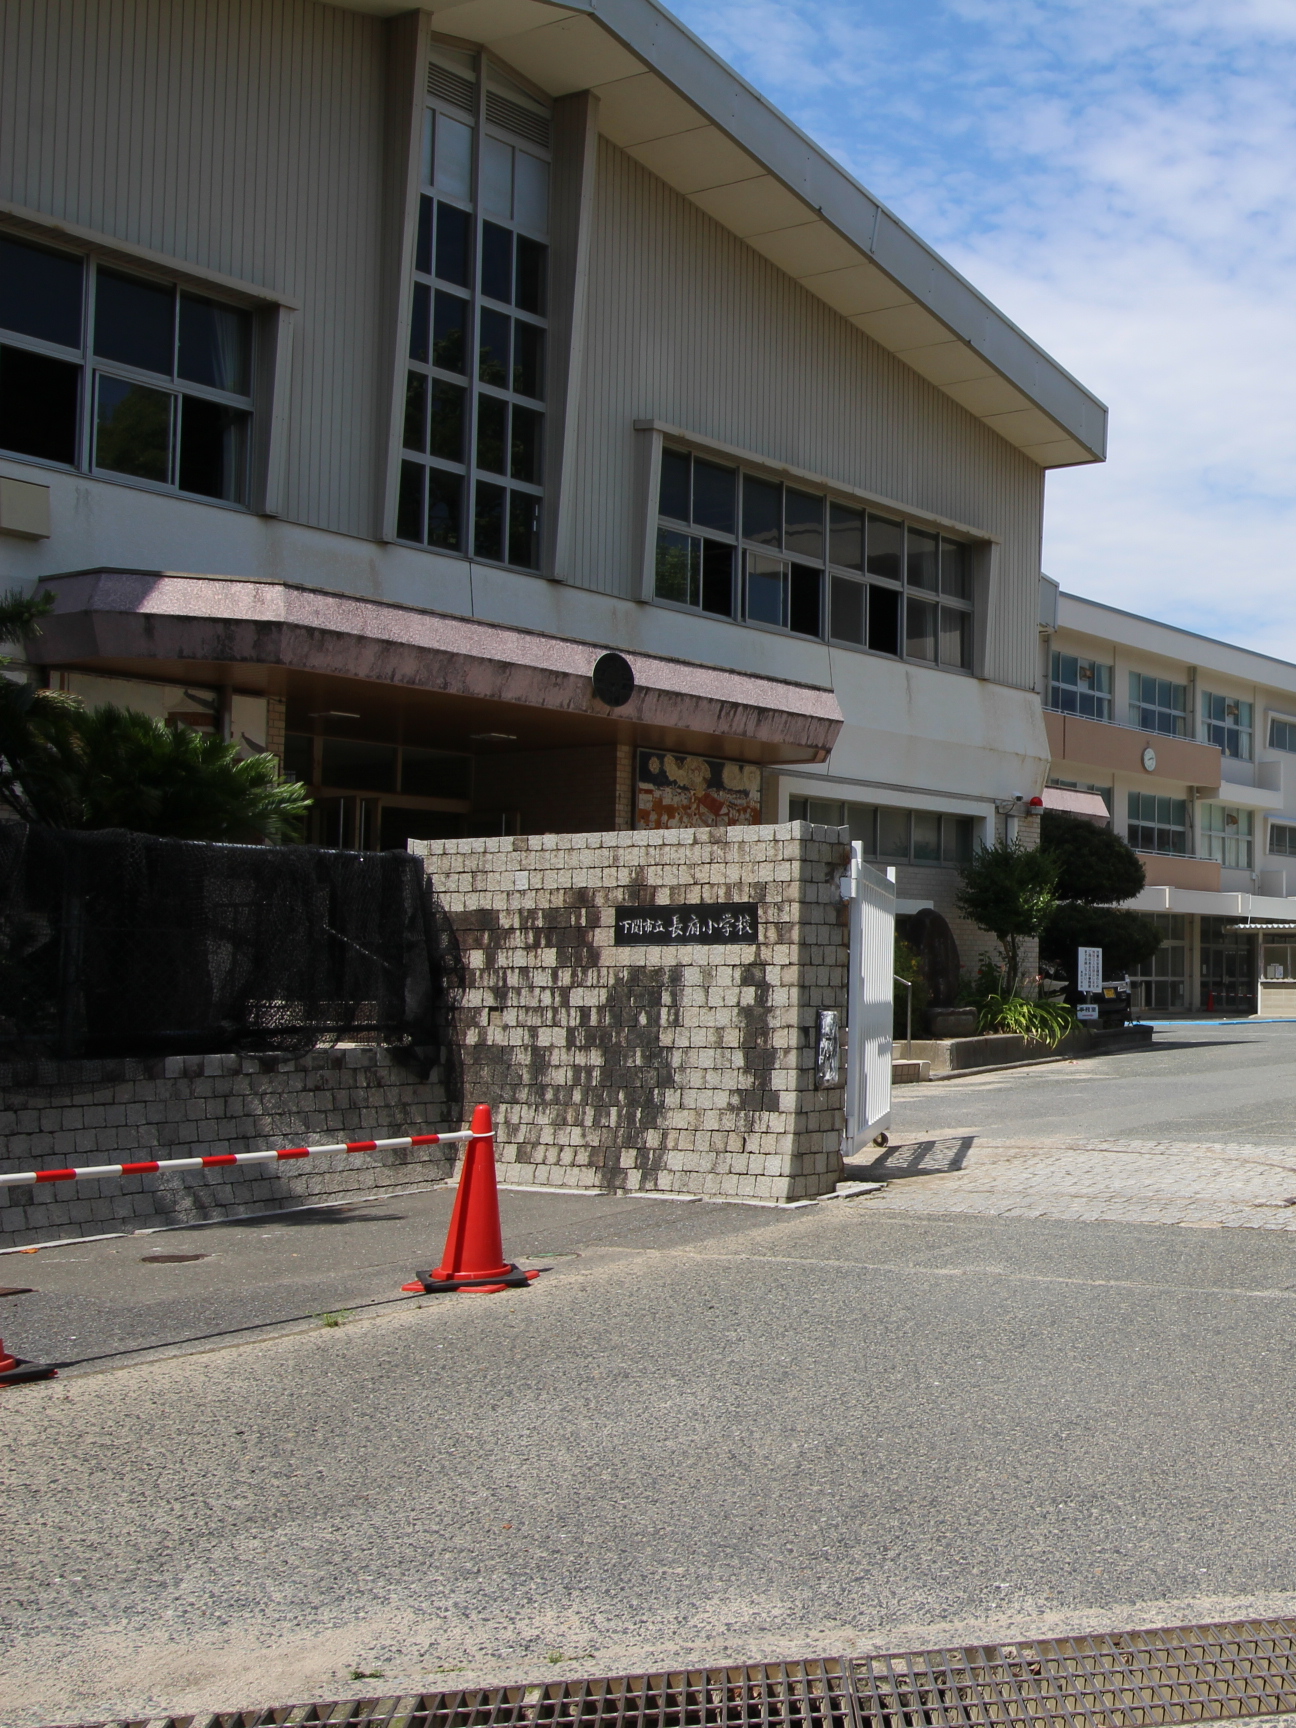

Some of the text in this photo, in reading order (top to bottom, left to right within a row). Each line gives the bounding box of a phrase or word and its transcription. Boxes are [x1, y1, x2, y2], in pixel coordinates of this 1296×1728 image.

[619, 913, 754, 937] 下関市立長府小学校
